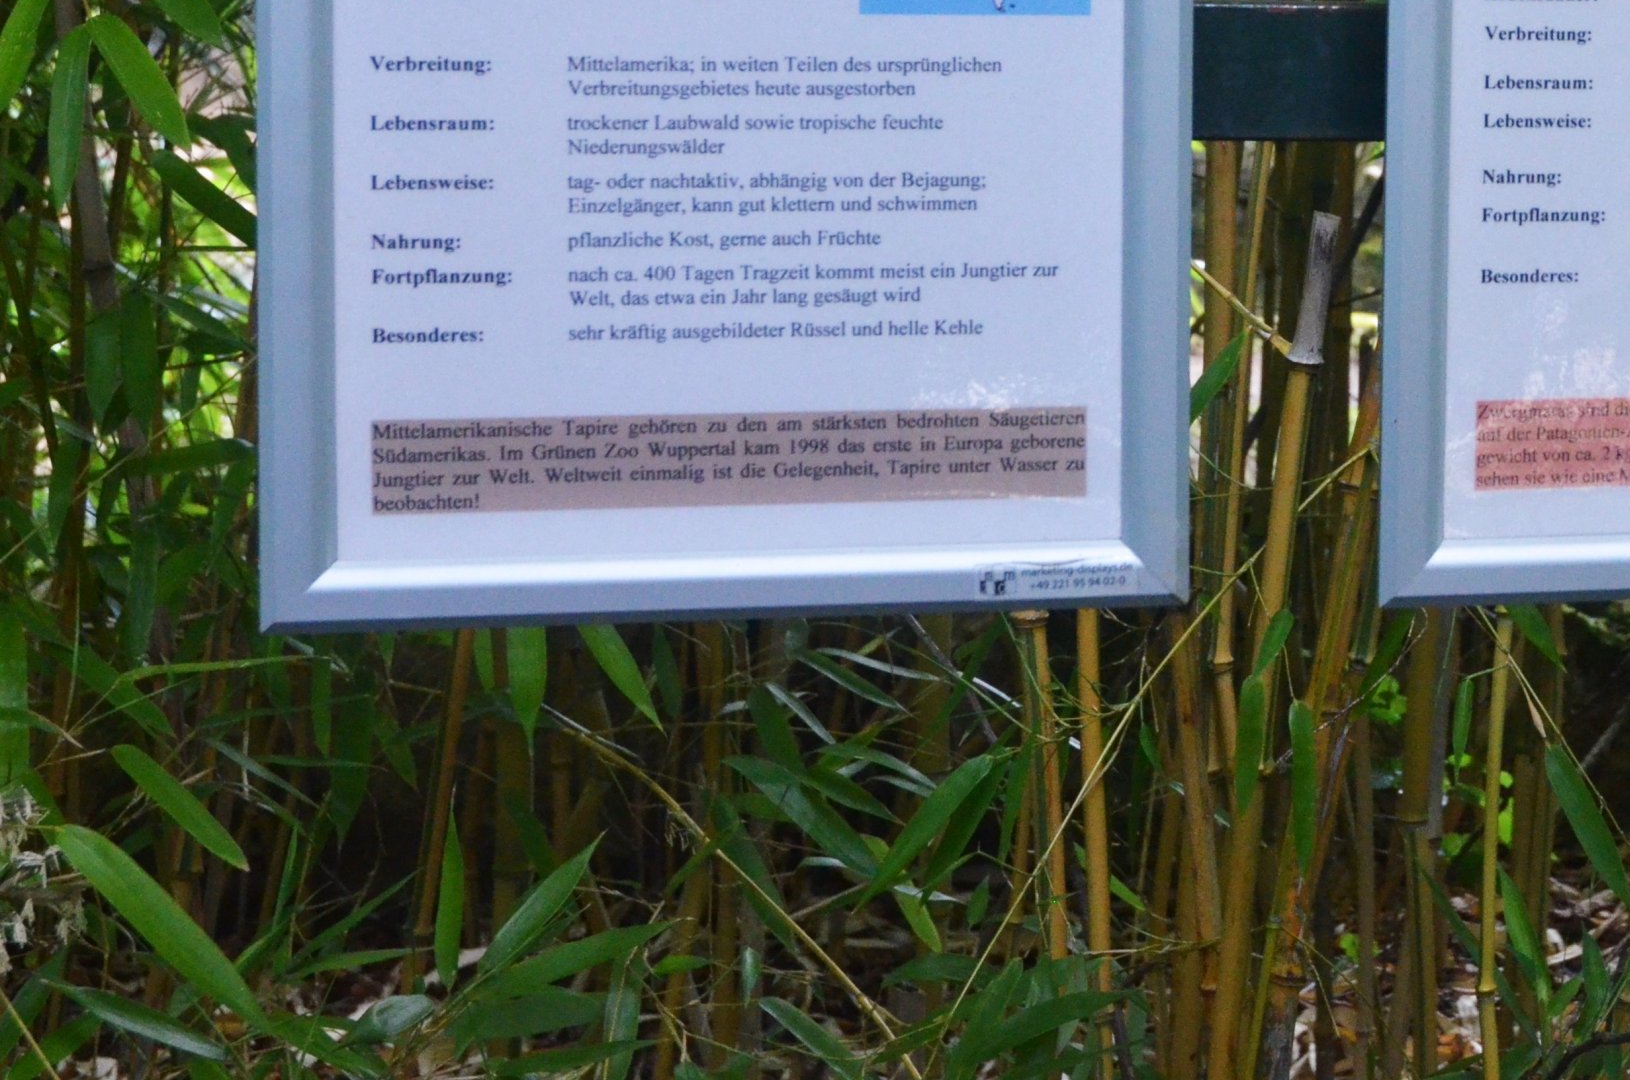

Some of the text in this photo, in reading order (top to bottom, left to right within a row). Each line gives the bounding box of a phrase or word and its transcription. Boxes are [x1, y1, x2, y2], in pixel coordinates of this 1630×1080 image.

[1485, 25, 1591, 45] Verbreitung:
[370, 55, 491, 76] Verbreitung:
[568, 79, 916, 101] Verbreitungsgebietes heute ausgestorben
[1484, 74, 1593, 91] Lebensraum:
[371, 115, 494, 132] Lebensraum:
[1484, 113, 1591, 129] Lebensweise:
[567, 138, 725, 160] Niederungswälder
[371, 174, 493, 191] Lebensweise:
[1483, 169, 1561, 188] Nahrung:
[1482, 207, 1605, 227] Fortpflanzung:
[372, 233, 460, 253] Nahrung:
[372, 267, 512, 289] Fortpflanzung:
[1481, 268, 1578, 284] Besonderes:
[372, 326, 483, 344] Besonderes:
[373, 410, 1085, 440] Mittelamerikanische Tapire gehören zu den am stärksten bedrohten Säugetieren
[374, 492, 479, 512] beobachten!
